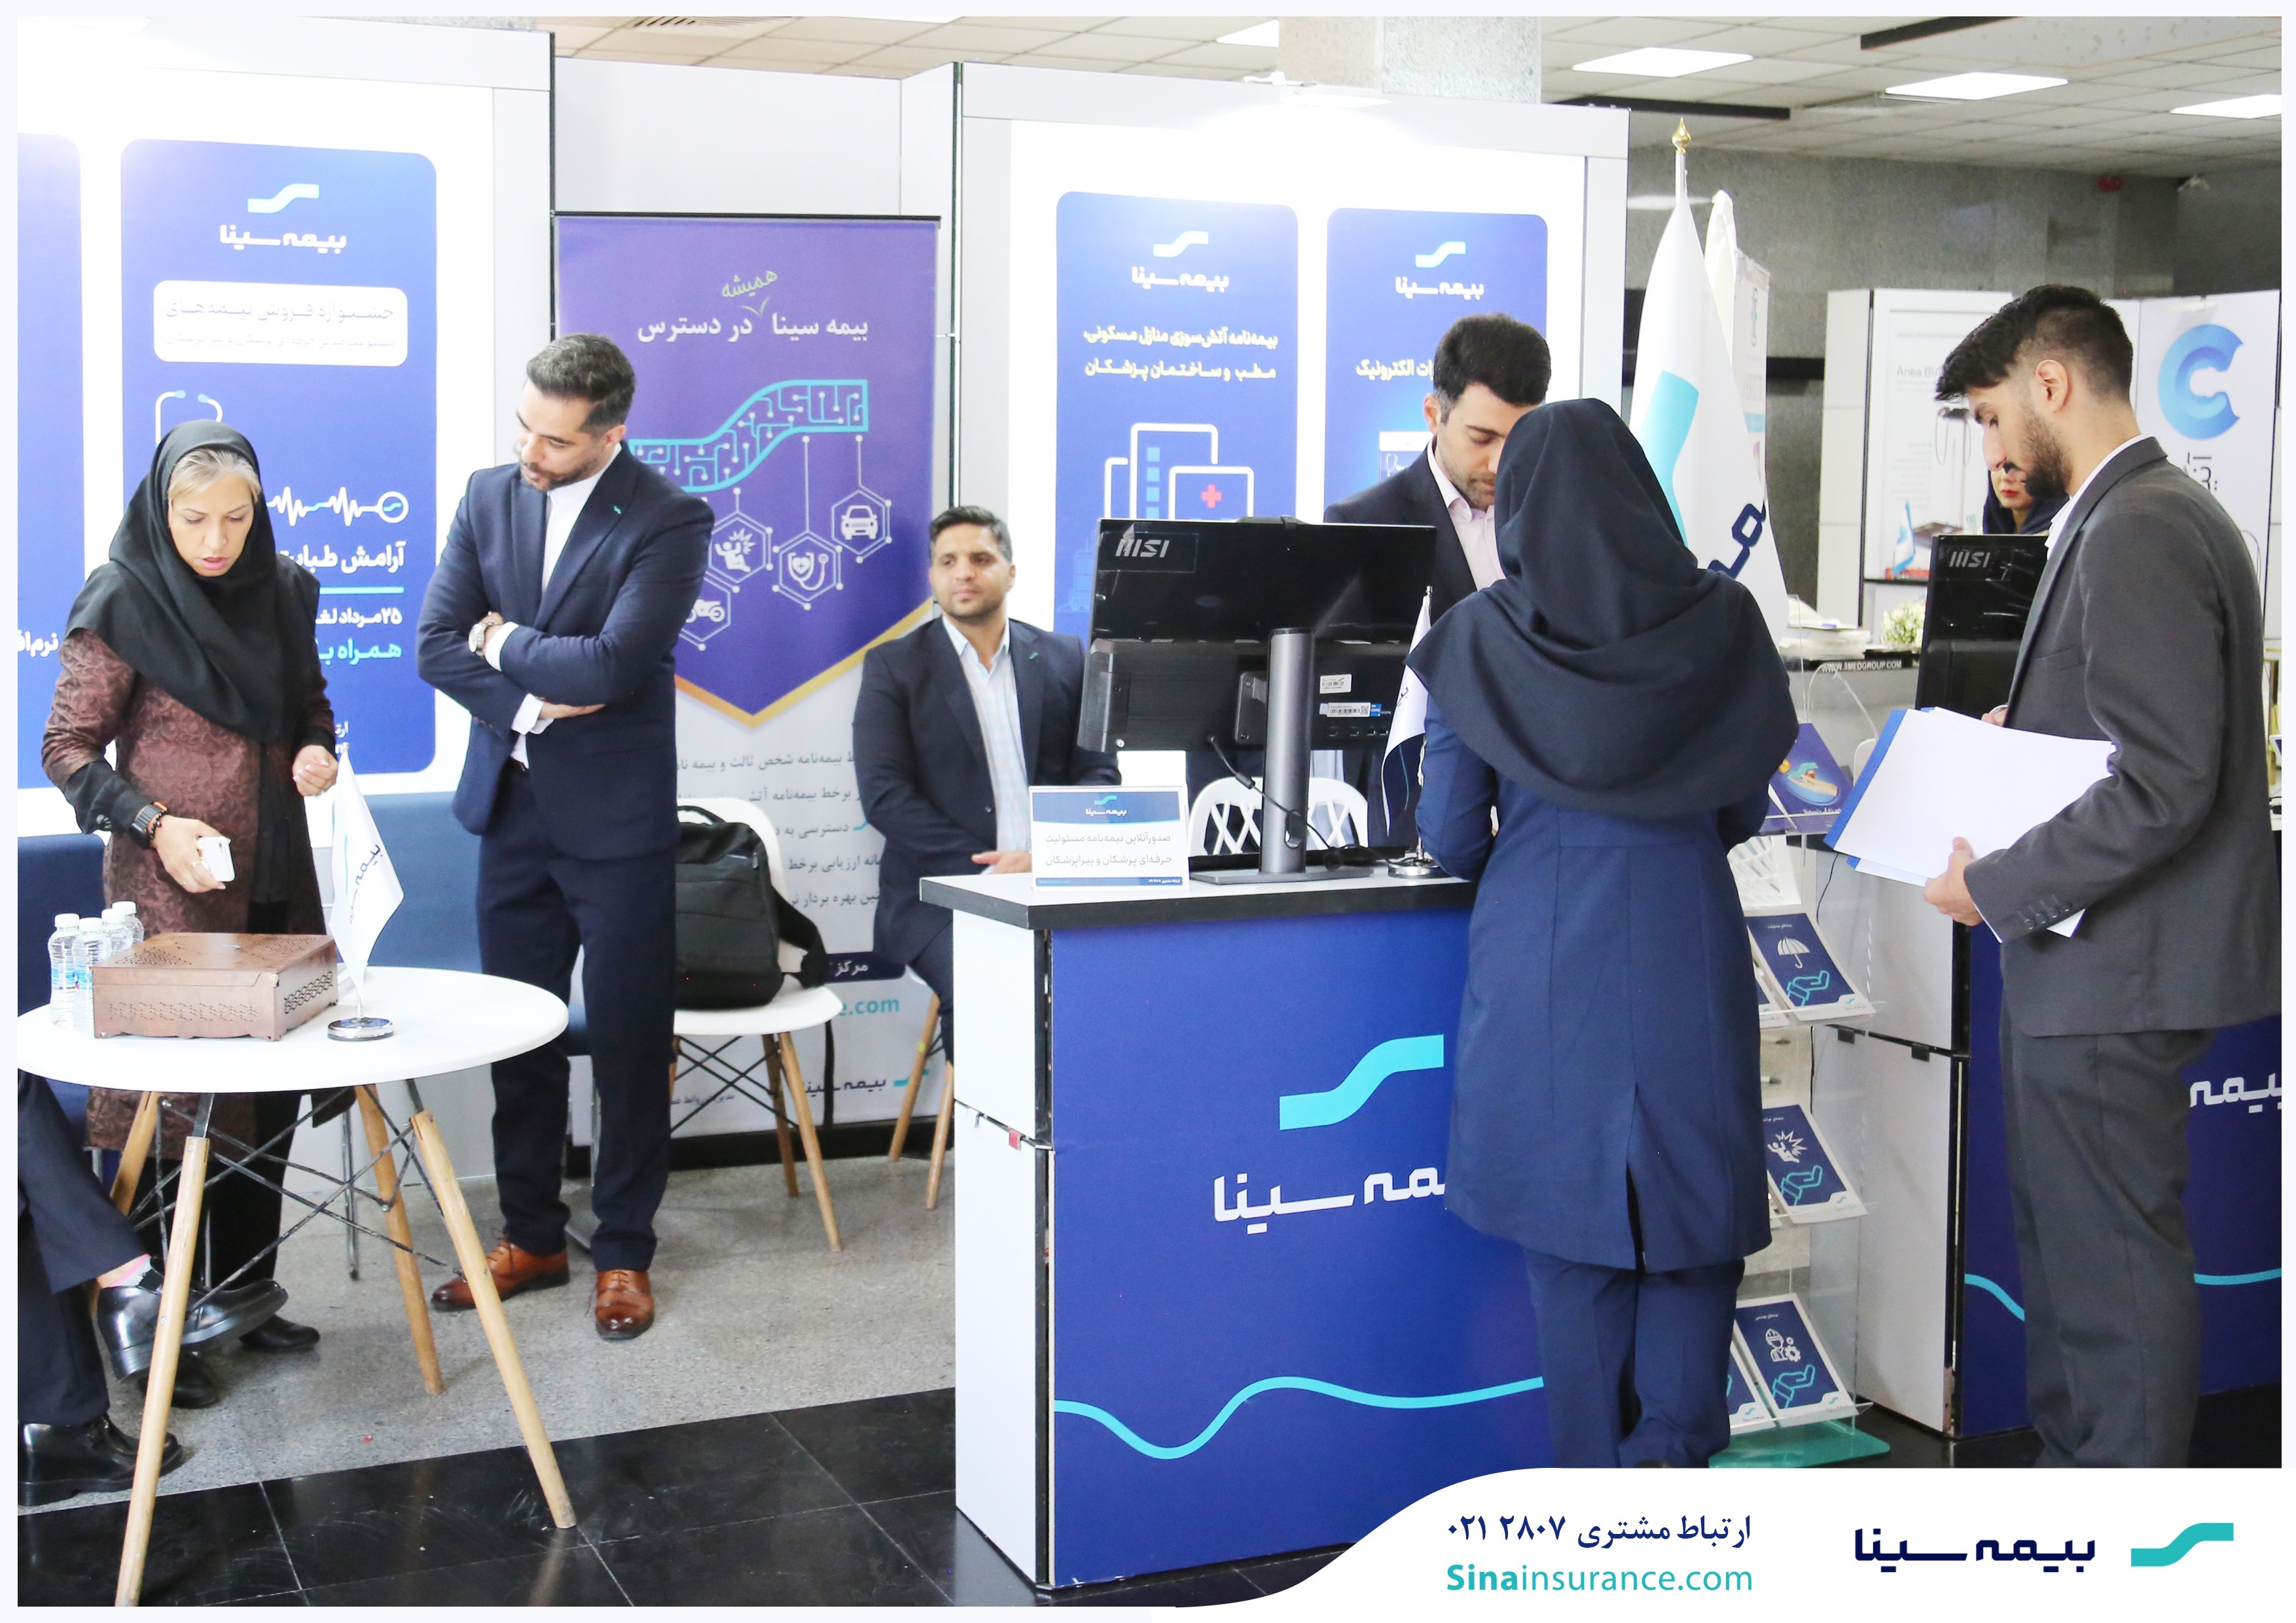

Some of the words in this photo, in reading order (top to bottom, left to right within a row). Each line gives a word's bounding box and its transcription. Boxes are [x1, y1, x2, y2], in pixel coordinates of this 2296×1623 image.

[219, 224, 282, 251] سینا
[283, 232, 348, 254] بیمه
[721, 269, 778, 298] همیشه
[1132, 266, 1179, 289] سینا
[1179, 272, 1229, 293] بیمه
[1395, 276, 1439, 299] سینا
[1439, 281, 1484, 300] بیمه
[637, 315, 722, 342] دسترس
[727, 318, 753, 342] در
[771, 312, 819, 342] سینا
[825, 318, 869, 342] بیمه
[1139, 326, 1169, 346] منازل
[1085, 357, 1149, 382] پزشکان
[1150, 360, 1222, 380] ساختمان
[1223, 367, 1231, 382] و
[1234, 363, 1276, 382] مطب
[1355, 358, 1415, 382] الکترونیک
[340, 541, 407, 574] آرامش
[337, 637, 403, 666] همراه
[692, 760, 715, 773] بیمه
[729, 755, 753, 768] ثالث
[758, 755, 793, 770] شخص
[798, 823, 849, 839] دسترسی
[1045, 833, 1085, 846] مسئولیت
[1102, 854, 1137, 868] پزشکان
[834, 959, 869, 978] مرکز
[844, 1079, 886, 1093] بیمه
[1213, 1173, 1355, 1235] سینا
